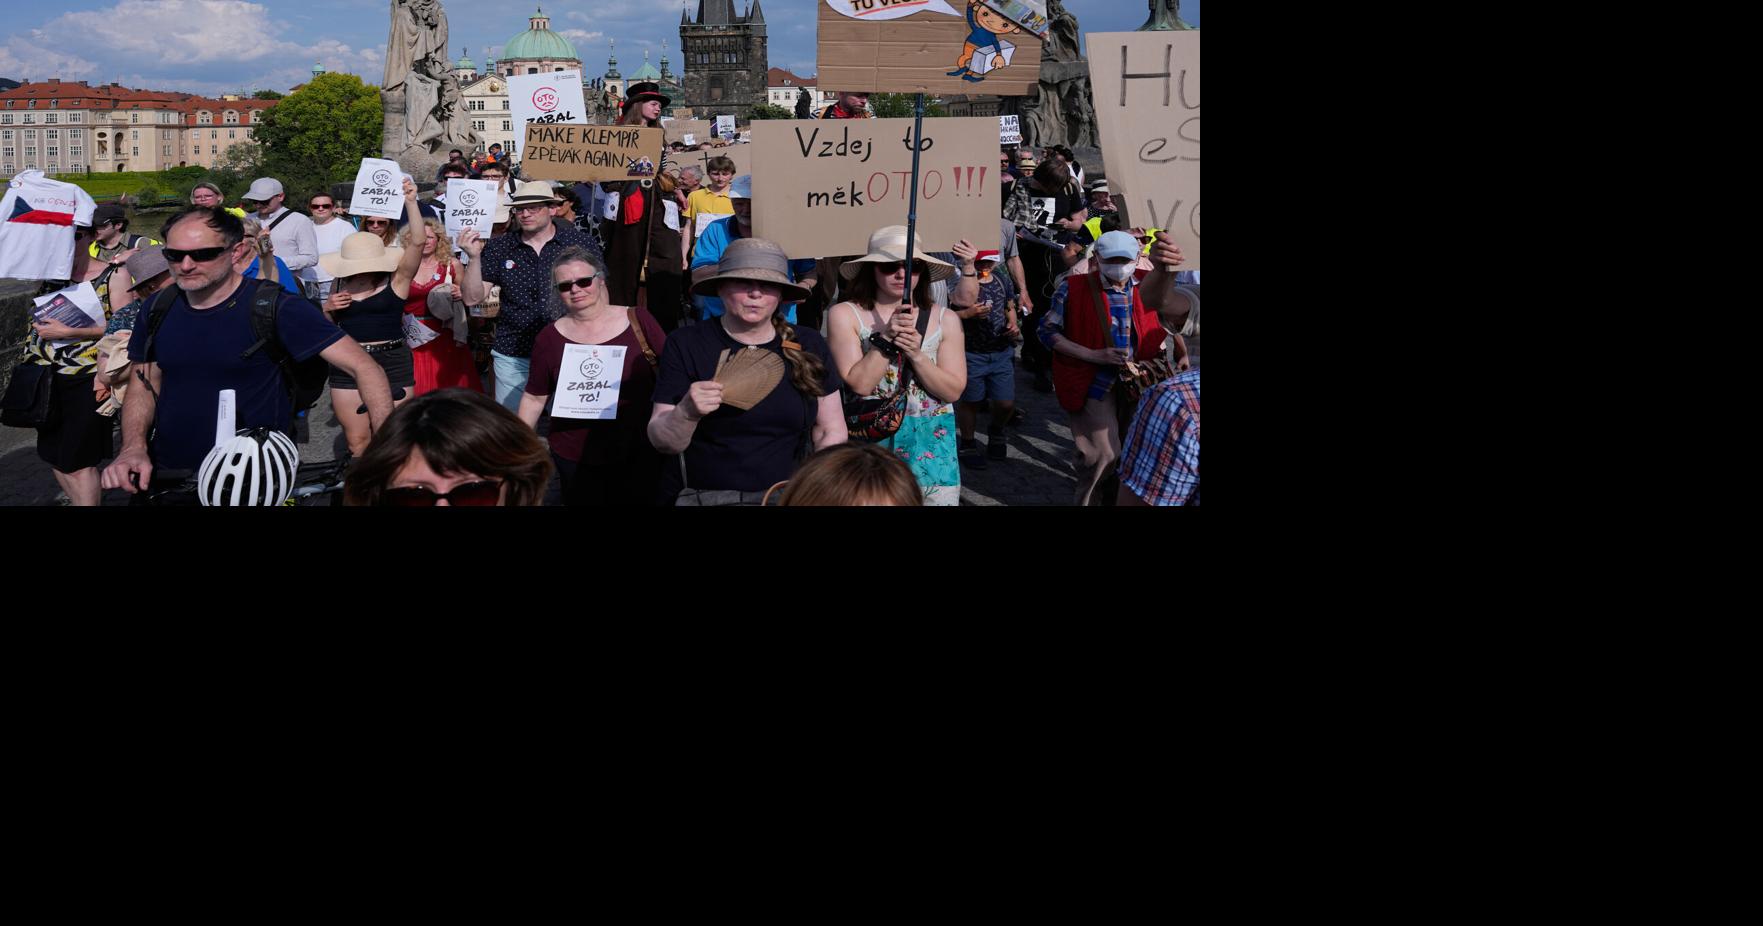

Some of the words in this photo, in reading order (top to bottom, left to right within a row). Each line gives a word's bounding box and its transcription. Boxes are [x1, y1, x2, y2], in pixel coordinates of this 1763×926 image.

[528, 127, 575, 144] MAKE
[582, 128, 639, 149] KLEMPÍŘ
[795, 126, 872, 162] Vzdej
[903, 126, 933, 152] to
[527, 145, 582, 163] ZPĚVÁK
[584, 150, 625, 168] AGAIN
[361, 187, 398, 196] ZABAL
[370, 196, 389, 205] TO!
[451, 209, 487, 217] ZABAL
[460, 217, 478, 226] TO!
[567, 380, 611, 391] ZABAL
[579, 391, 600, 403] TO!
